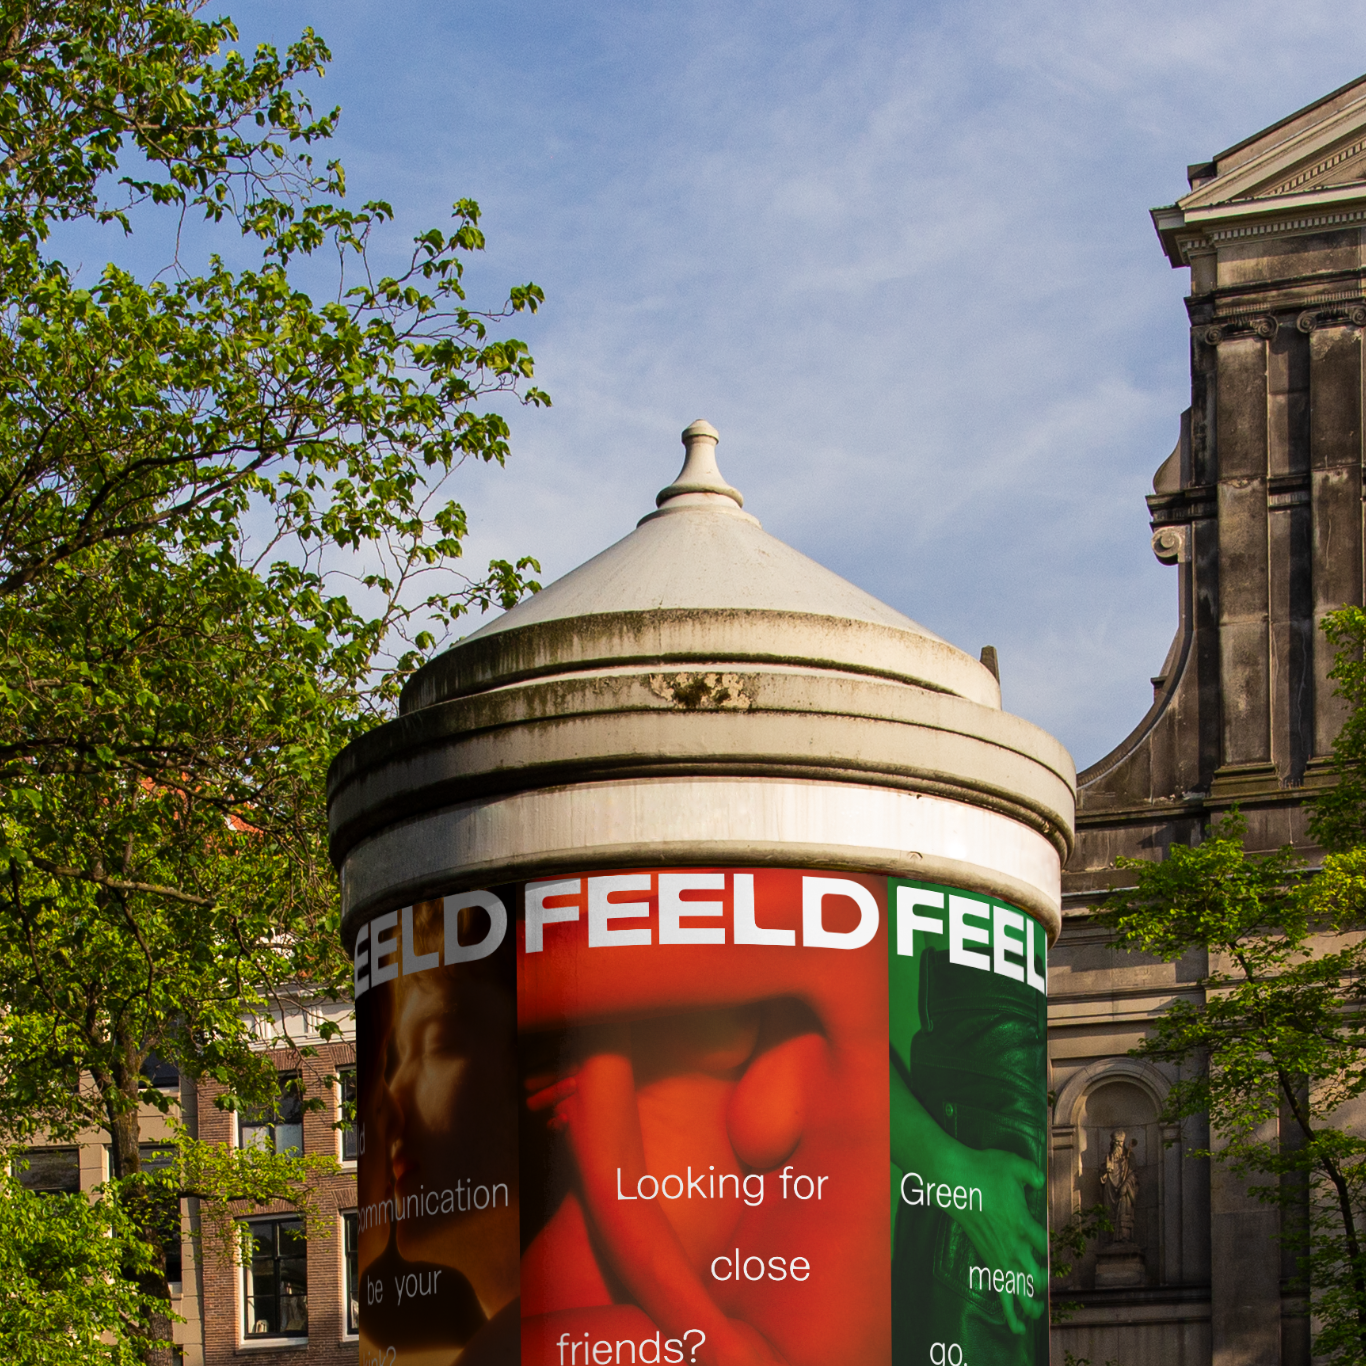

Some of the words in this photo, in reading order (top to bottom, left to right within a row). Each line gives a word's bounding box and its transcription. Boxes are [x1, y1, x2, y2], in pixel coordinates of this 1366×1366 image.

[525, 873, 880, 954] FEELD
[897, 885, 1048, 998] FEEL
[617, 1166, 765, 1207] Looking
[779, 1166, 829, 1200] for
[900, 1172, 983, 1212] Green
[710, 1248, 811, 1281] close
[969, 1266, 1035, 1298] means
[367, 1275, 384, 1306] be
[394, 1269, 443, 1307] your
[556, 1329, 706, 1366] friends?
